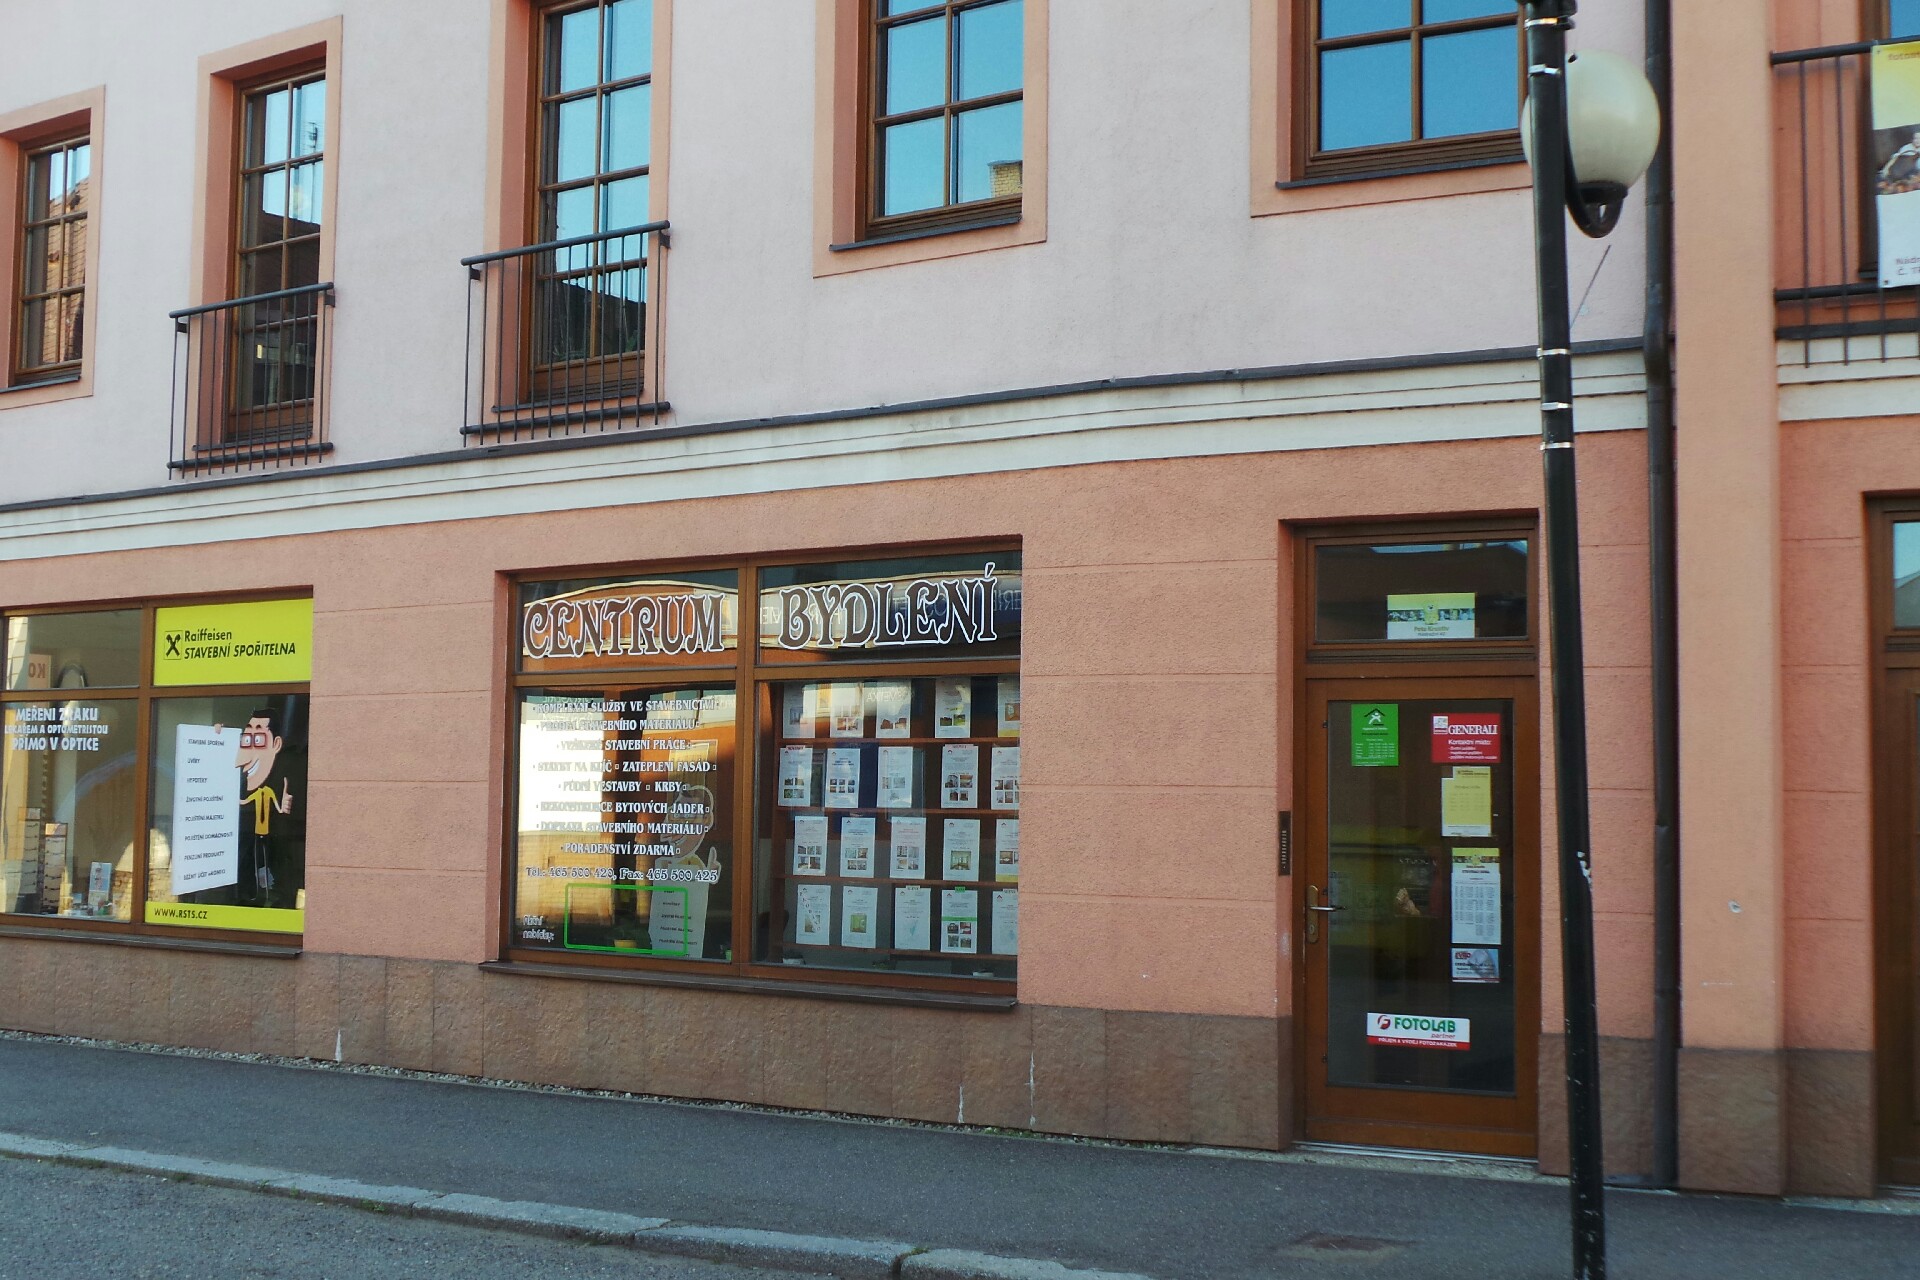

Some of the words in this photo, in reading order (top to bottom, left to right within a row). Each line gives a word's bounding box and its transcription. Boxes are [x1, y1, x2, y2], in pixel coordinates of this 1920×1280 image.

[524, 593, 726, 659] CENTRUM
[778, 562, 998, 650] BYDLENÍ
[185, 628, 232, 642] Raiffeisen
[184, 642, 231, 659] STAVEBNÍ
[233, 640, 296, 657] SPOŘITELNA
[537, 701, 590, 713] KOMPLEXNÍ
[591, 700, 626, 712] SLUŽBY
[630, 700, 643, 712] VE
[646, 697, 715, 711] STAVEBNICTVÍ
[59, 707, 98, 721] ZRAKU
[39, 724, 45, 734] A
[47, 724, 109, 735] OPTOMETRISTOU
[581, 718, 637, 731] STAVEBNÍHO
[640, 718, 696, 731] MATERIÁLU
[1448, 724, 1498, 735] GENERALI
[50, 737, 59, 750] V
[61, 737, 99, 751] OPTICE
[605, 737, 650, 750] STAVEBNÍ
[653, 737, 686, 750] PRÁCE
[590, 759, 612, 772] KLÍČ
[677, 759, 710, 771] FASÁD
[593, 781, 641, 791] VESTAVBY
[655, 781, 682, 791] KRBY
[616, 800, 667, 814] BYTOVÝCH
[670, 802, 704, 814] JADER
[586, 820, 644, 833] STAVEBNÍHO
[647, 820, 703, 834] MATERIÁLU
[564, 841, 630, 854] PORADENSTVÍ
[633, 844, 675, 855] ZDARMA
[526, 866, 546, 878] Tel.:
[548, 866, 568, 878] 465
[571, 867, 590, 878] 500
[594, 867, 616, 880] 420,
[620, 867, 644, 880] Fax:
[646, 868, 668, 881] 465
[670, 868, 693, 881] 500
[695, 868, 719, 882] 425
[154, 907, 208, 919] WWW.RSTS.CZ
[1394, 1017, 1456, 1033] FOTOLAB
